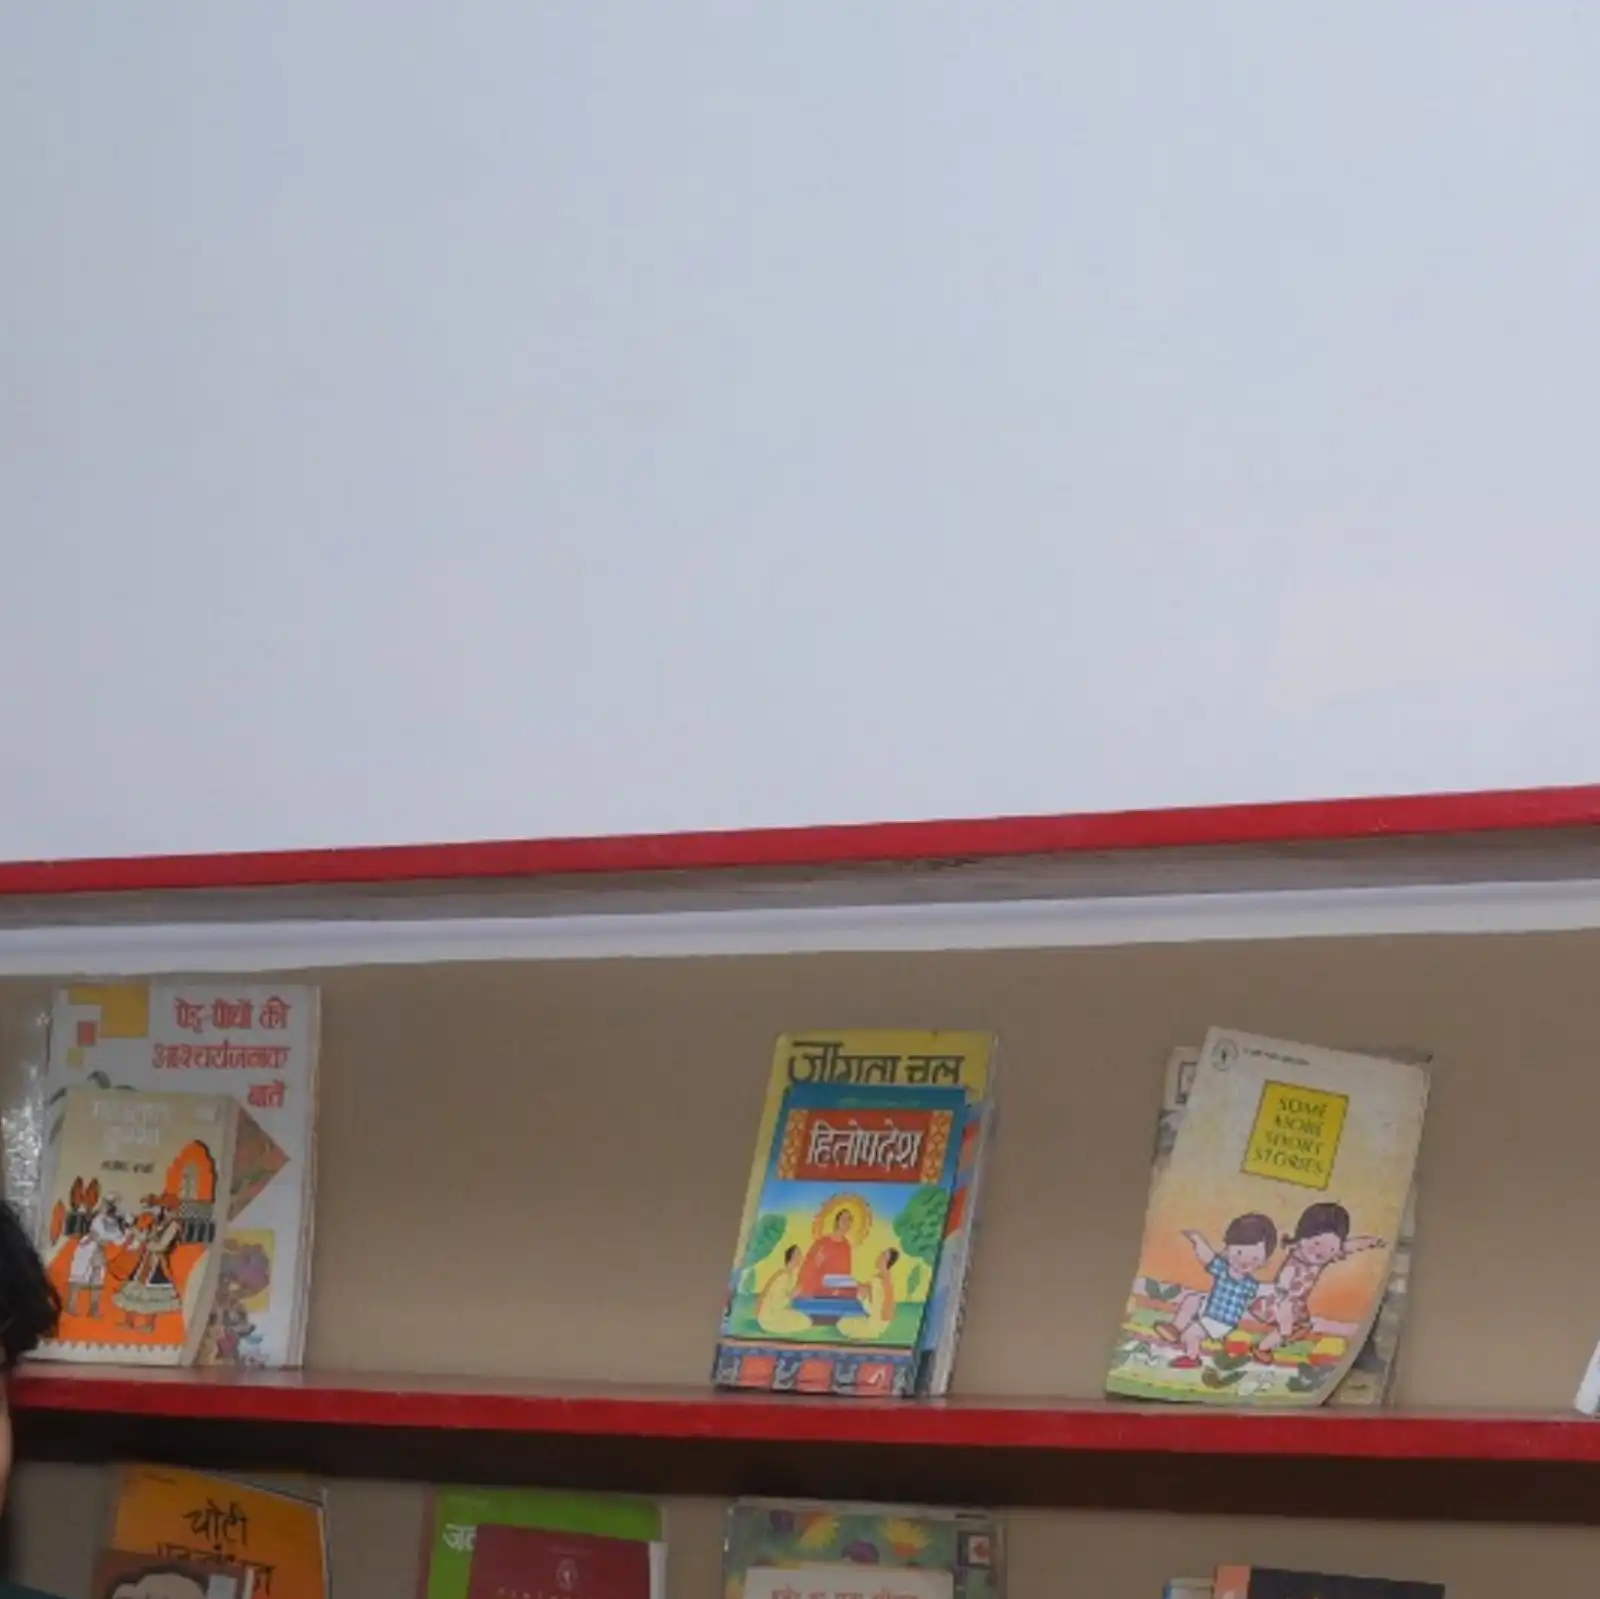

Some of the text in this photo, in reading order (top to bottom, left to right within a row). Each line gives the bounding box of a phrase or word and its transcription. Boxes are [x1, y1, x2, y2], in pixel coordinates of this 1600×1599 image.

[258, 995, 292, 1030] की
[905, 1053, 965, 1085] चल
[1277, 1096, 1330, 1119] SOME
[1273, 1115, 1325, 1138] MORE
[806, 1118, 923, 1174] हितोपदेश
[1264, 1131, 1325, 1157] SHORT
[1251, 1147, 1324, 1175] STORIES
